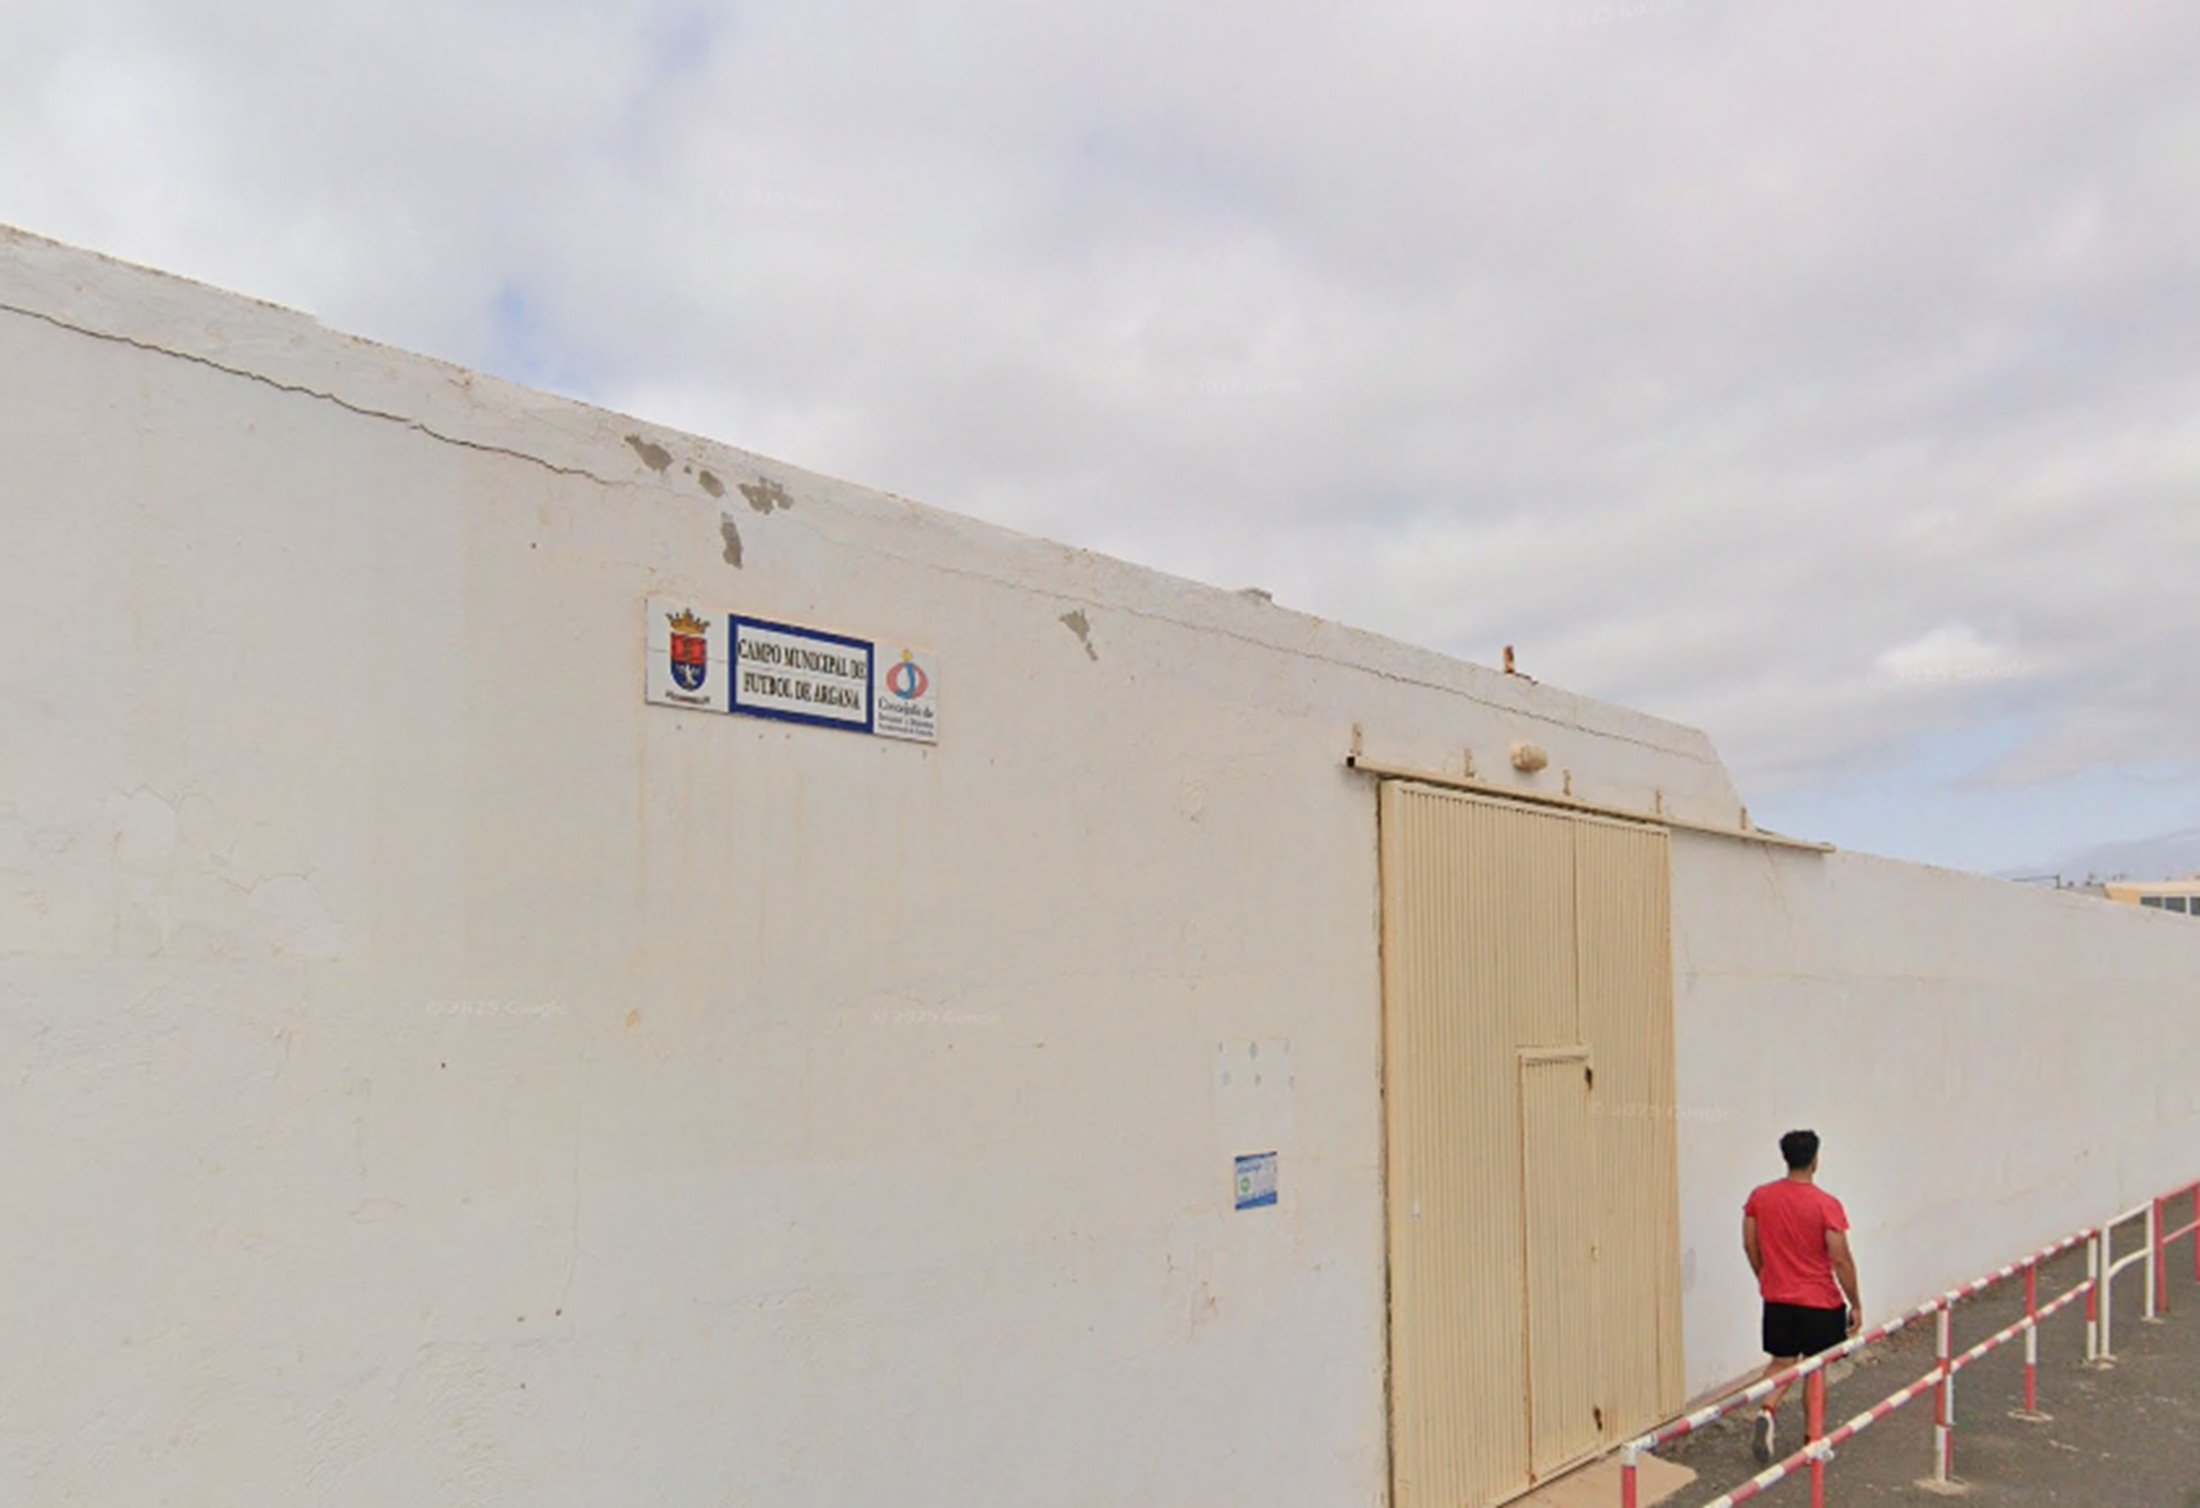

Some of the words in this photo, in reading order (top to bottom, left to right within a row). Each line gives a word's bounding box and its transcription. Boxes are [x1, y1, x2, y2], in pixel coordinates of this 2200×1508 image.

[737, 638, 781, 664] CAMPO
[784, 646, 848, 677] MUNICIPAL
[850, 660, 866, 680] DE
[795, 680, 812, 702] DE
